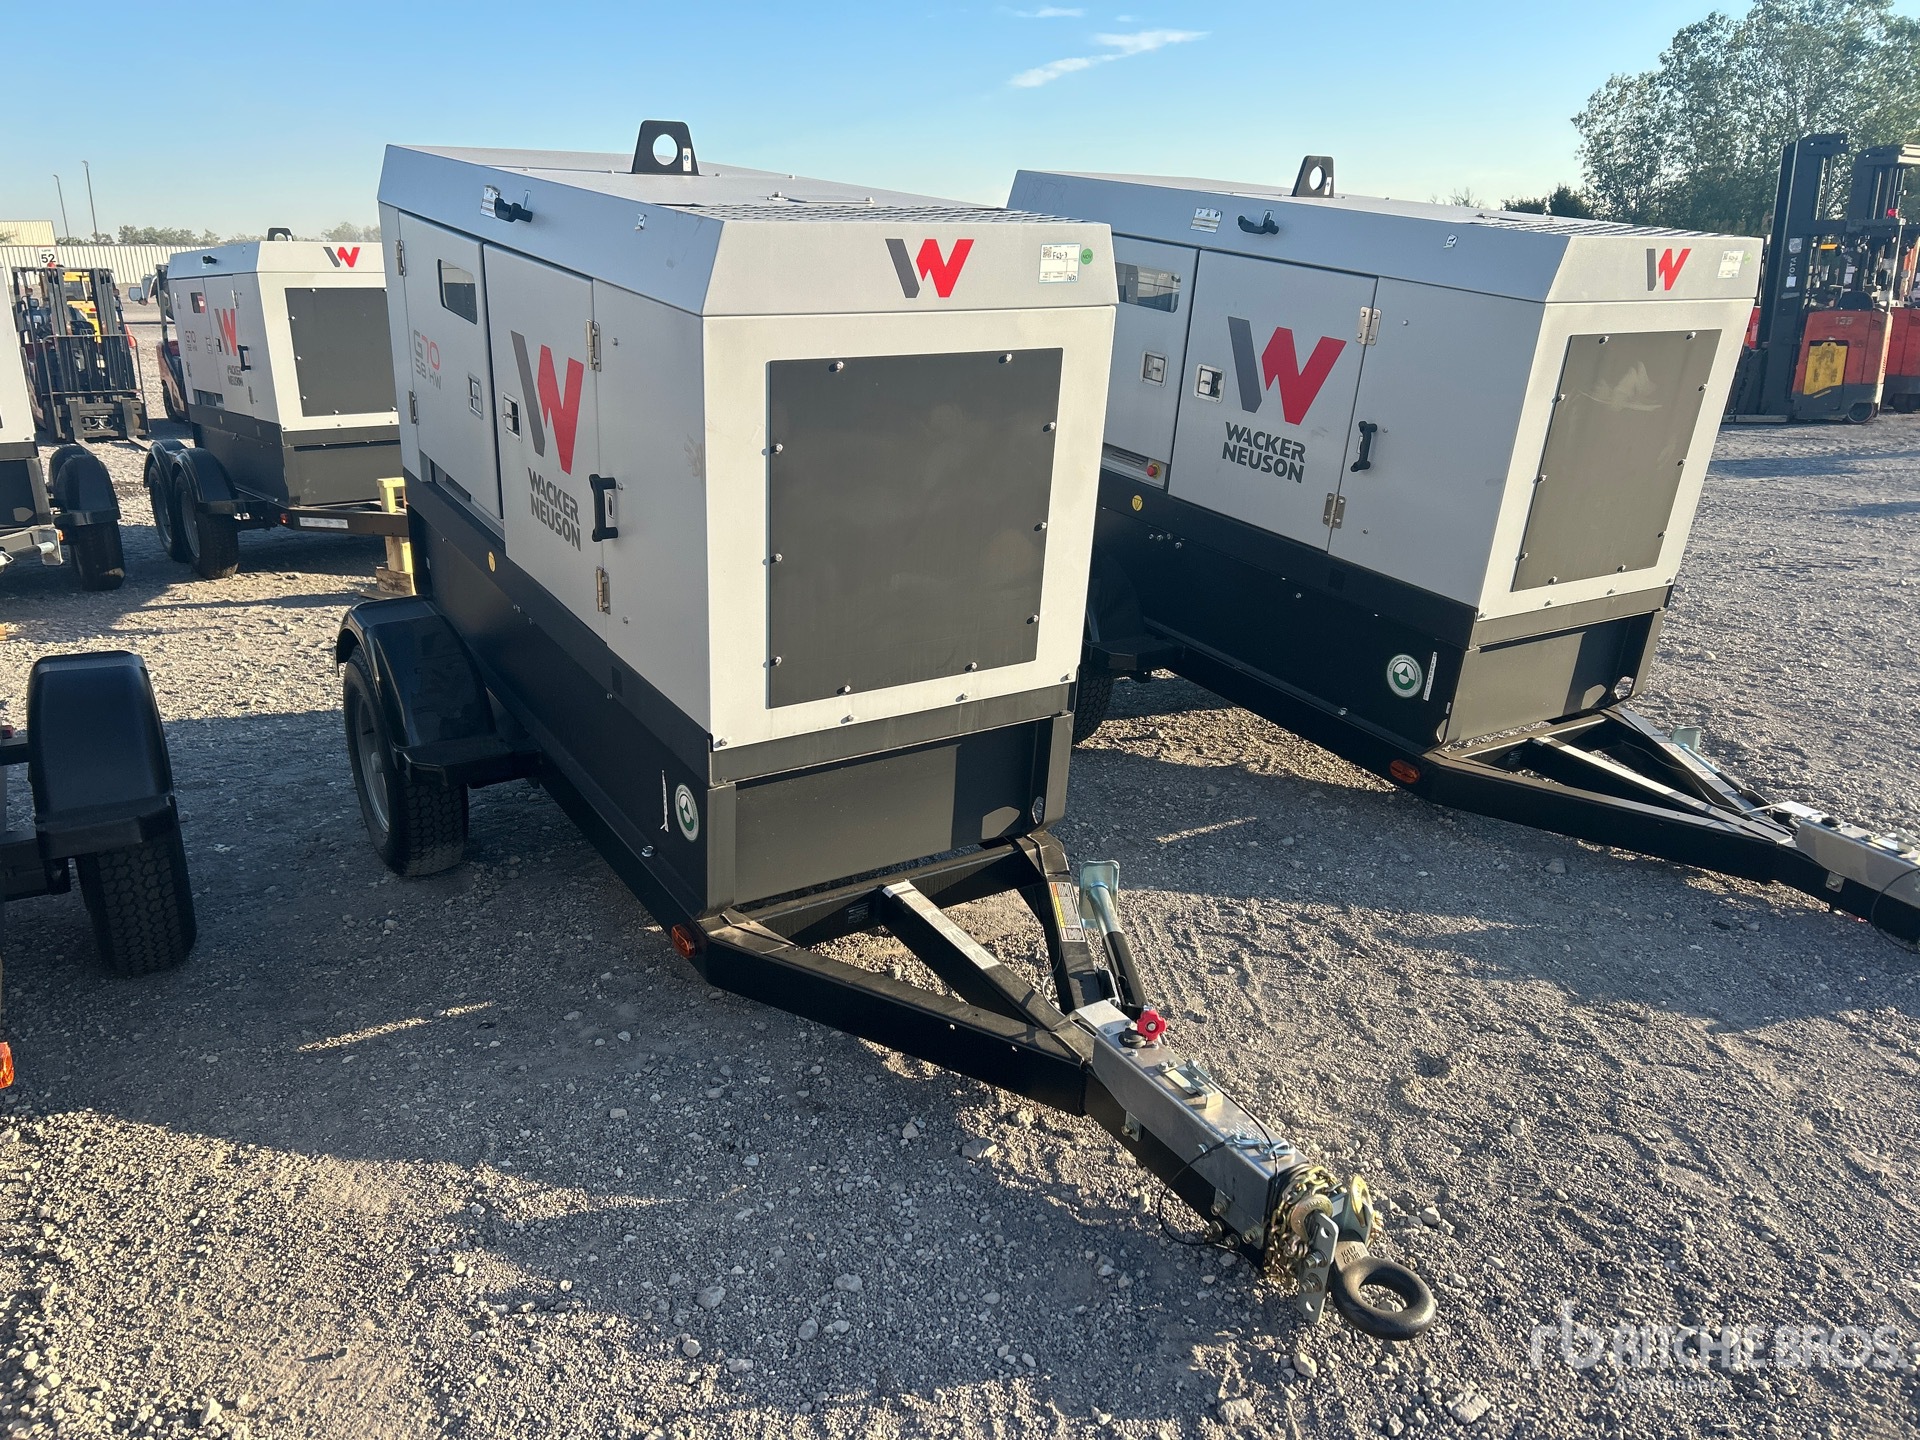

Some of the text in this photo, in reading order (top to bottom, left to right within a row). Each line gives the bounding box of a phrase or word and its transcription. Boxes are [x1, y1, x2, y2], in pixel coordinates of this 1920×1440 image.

[41, 253, 56, 263] 52
[413, 329, 441, 371] G70
[427, 367, 442, 391] HW
[1222, 441, 1305, 484] NEUSON
[1225, 421, 1306, 464] WACKER
[527, 466, 580, 526] WACKER
[530, 492, 582, 552] NEUSON
